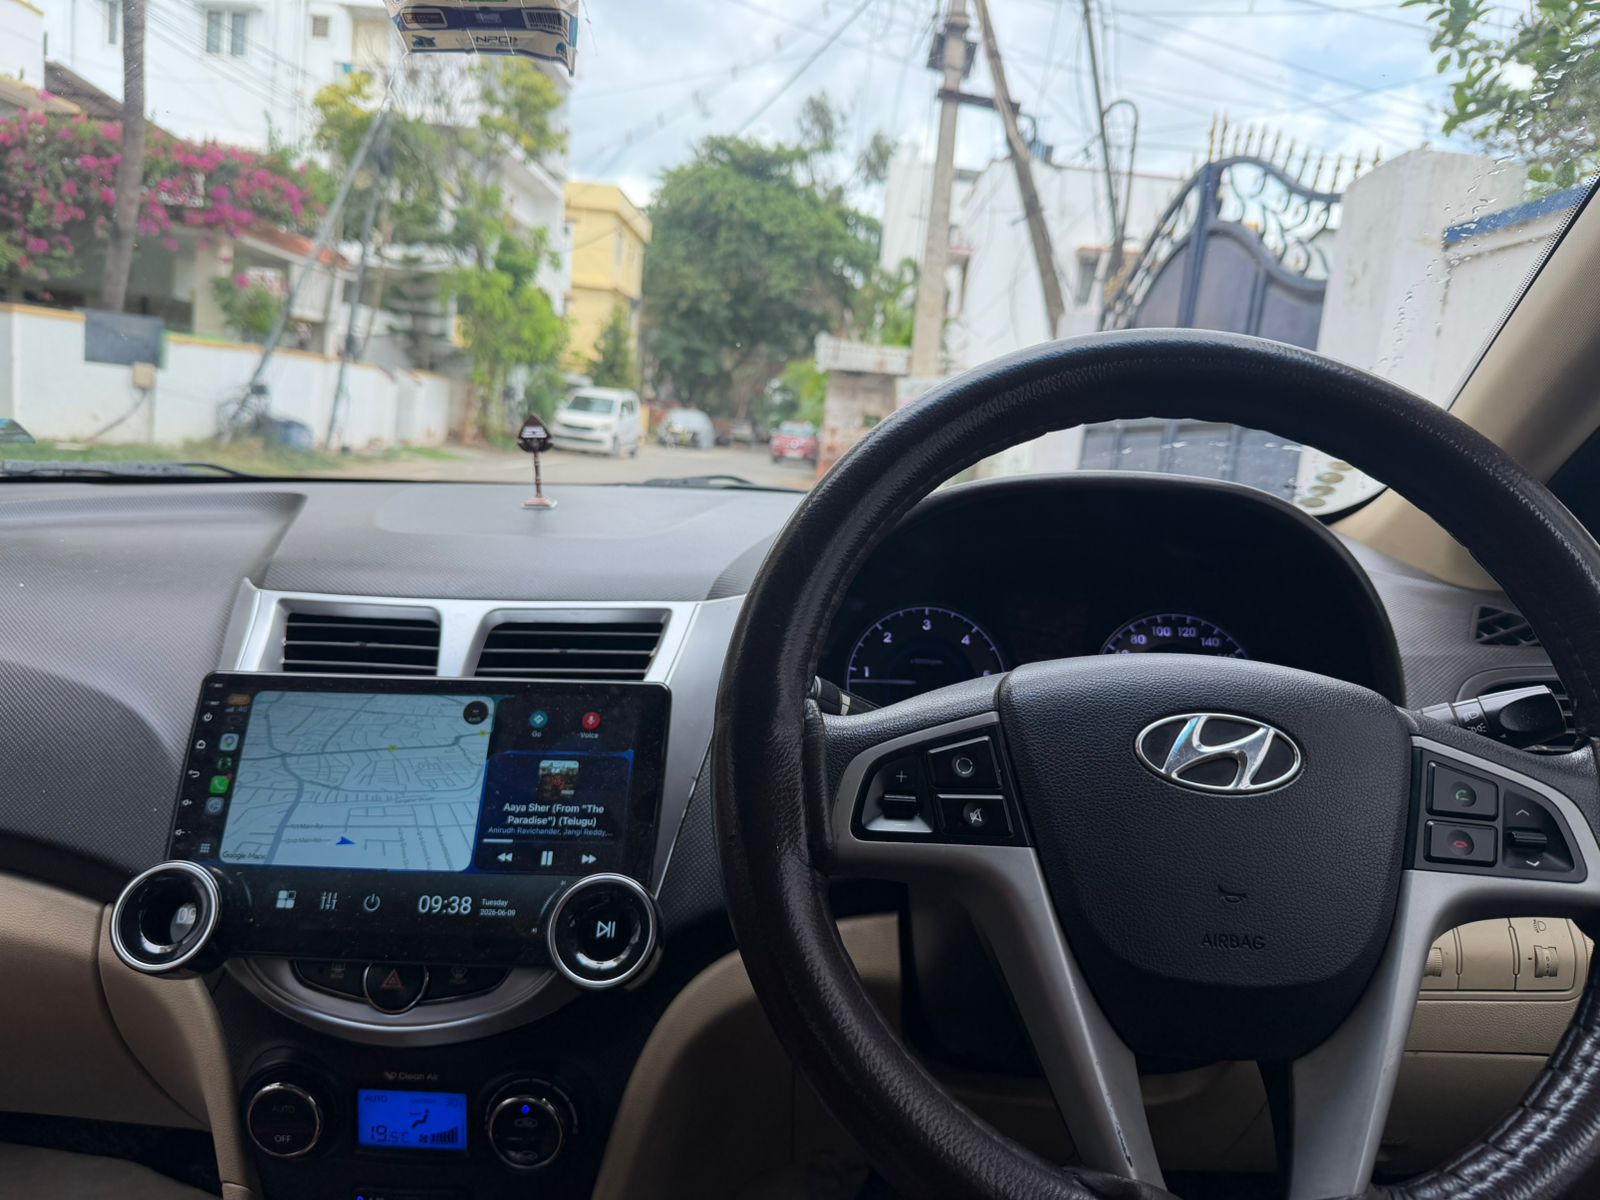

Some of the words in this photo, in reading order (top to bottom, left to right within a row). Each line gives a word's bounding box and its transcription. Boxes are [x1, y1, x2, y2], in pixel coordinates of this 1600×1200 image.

[922, 619, 931, 631] 3
[883, 631, 892, 643] 2
[1152, 626, 1172, 637] 100
[1178, 627, 1196, 637] 120
[961, 634, 970, 645] 4
[1130, 634, 1147, 645] 80
[1201, 637, 1220, 647] 140
[864, 666, 870, 677] 1
[503, 803, 526, 814] Aaya
[528, 803, 550, 813] Sher
[552, 803, 579, 814] (From
[582, 804, 605, 813] "The
[507, 815, 556, 826] Paradise")
[559, 816, 597, 827] (Telugu)
[488, 826, 515, 834] Anirudh
[222, 850, 246, 860] Google
[418, 895, 472, 914] 09:38
[482, 898, 508, 907] Tuesday
[1202, 933, 1266, 951] AIRBAG
[398, 1071, 425, 1081] Clean
[426, 1071, 440, 1081] Air
[271, 1104, 296, 1114] AUTO
[274, 1134, 292, 1144] OFF
